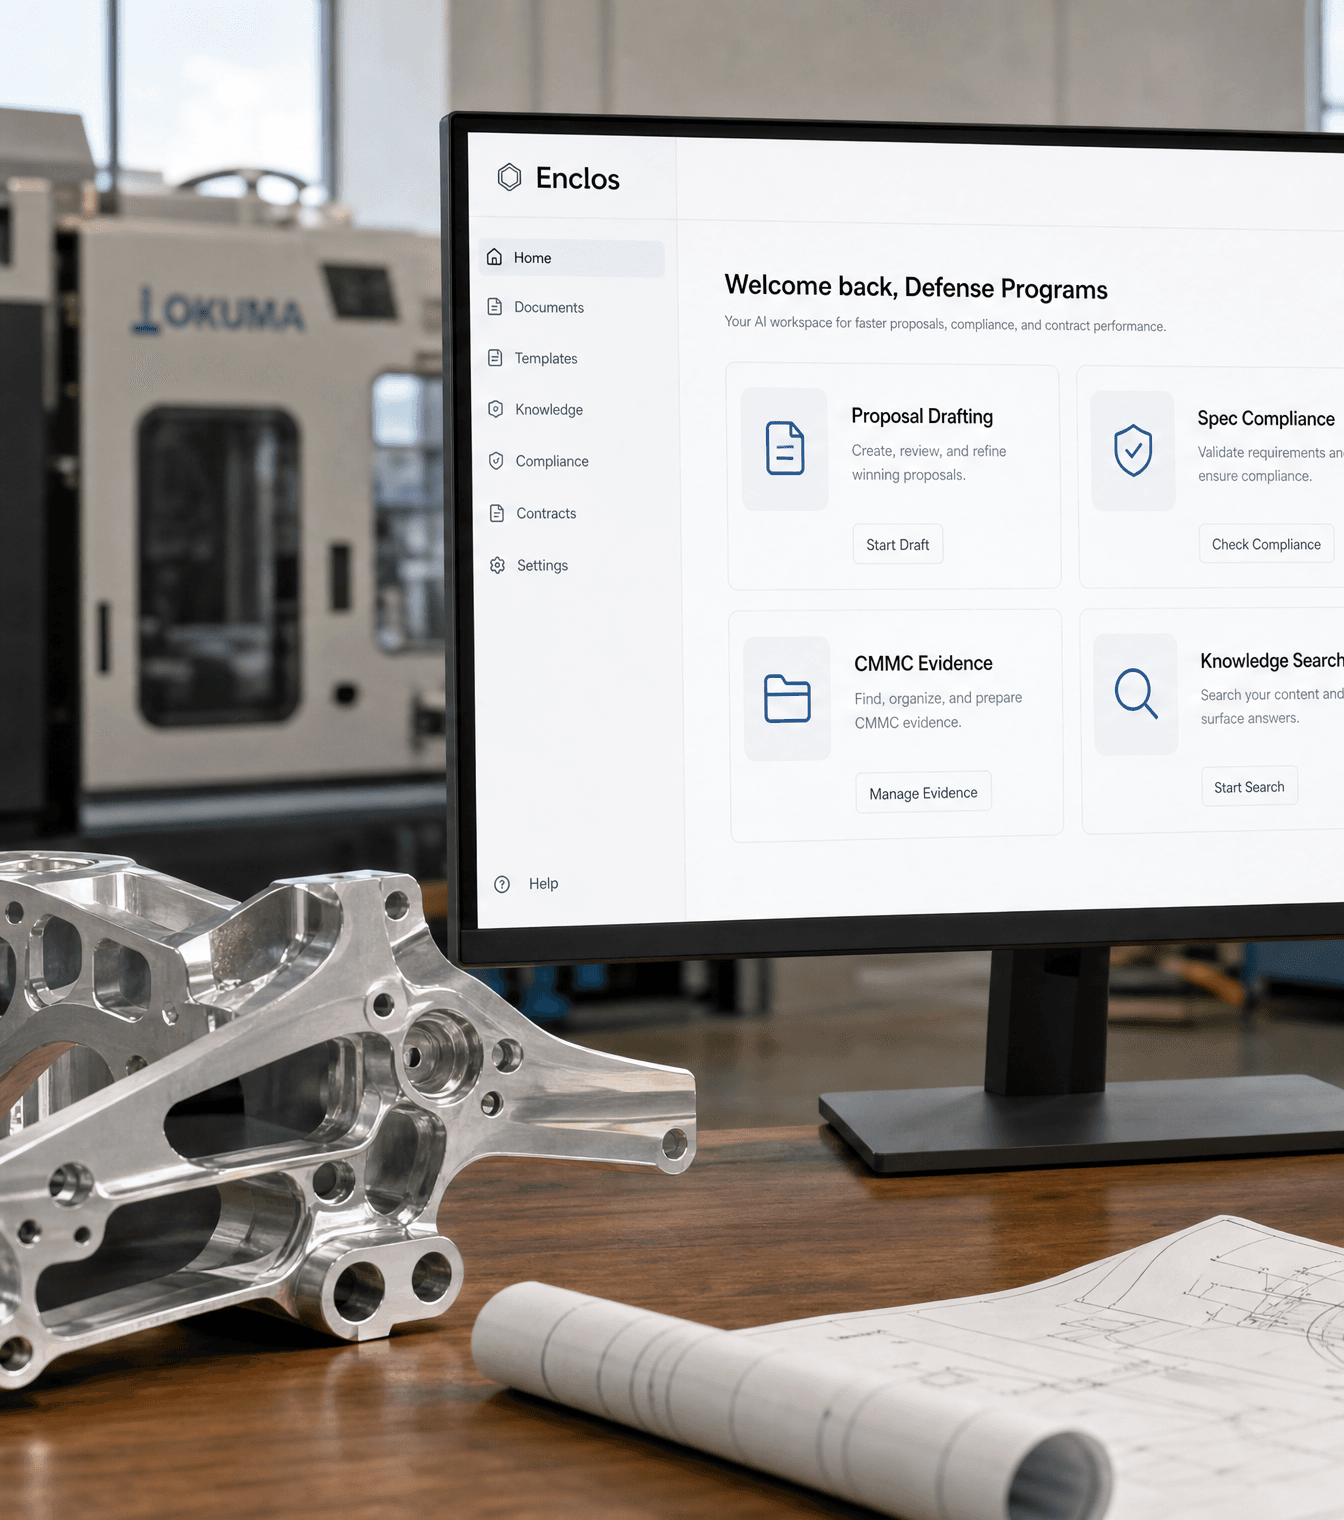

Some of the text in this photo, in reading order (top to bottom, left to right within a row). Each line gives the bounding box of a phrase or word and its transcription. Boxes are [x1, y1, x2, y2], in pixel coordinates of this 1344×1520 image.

[536, 165, 621, 191] Enclos
[514, 251, 552, 265] Home
[724, 273, 1109, 305] Welcome back, Defense Programs
[164, 292, 305, 332] OKUMA
[514, 300, 585, 314] Documents
[724, 314, 1167, 335] Your AI workspace for faster proposals, compliance, and contract performance.
[514, 351, 578, 368] Templates
[515, 402, 584, 419] Knowledge
[851, 406, 994, 429] Proposal Drafting
[1197, 409, 1336, 430] Spec Compliance
[851, 443, 1007, 459] Create, review, and refine
[1197, 445, 1245, 459] Validate
[1247, 445, 1326, 462] requirements
[515, 454, 590, 471] Compliance
[851, 467, 966, 484] winning proposals.
[1198, 469, 1313, 485] ensure compliance.
[516, 506, 577, 520] Contracts
[866, 537, 930, 552] Start Draft
[1211, 537, 1322, 554] Check Compliance
[517, 558, 569, 575] Settings
[854, 654, 994, 673] CMMC Evidence
[1200, 651, 1289, 673] Knowledge
[854, 690, 1023, 708] Find, organize, and prepare
[1200, 687, 1344, 704] Search your content and
[854, 715, 962, 730] CMMC evidence.
[1200, 711, 1300, 725] surface answers.
[869, 786, 978, 804] Manage Evidence
[1214, 780, 1285, 794] Start Search
[529, 876, 559, 893] Help
